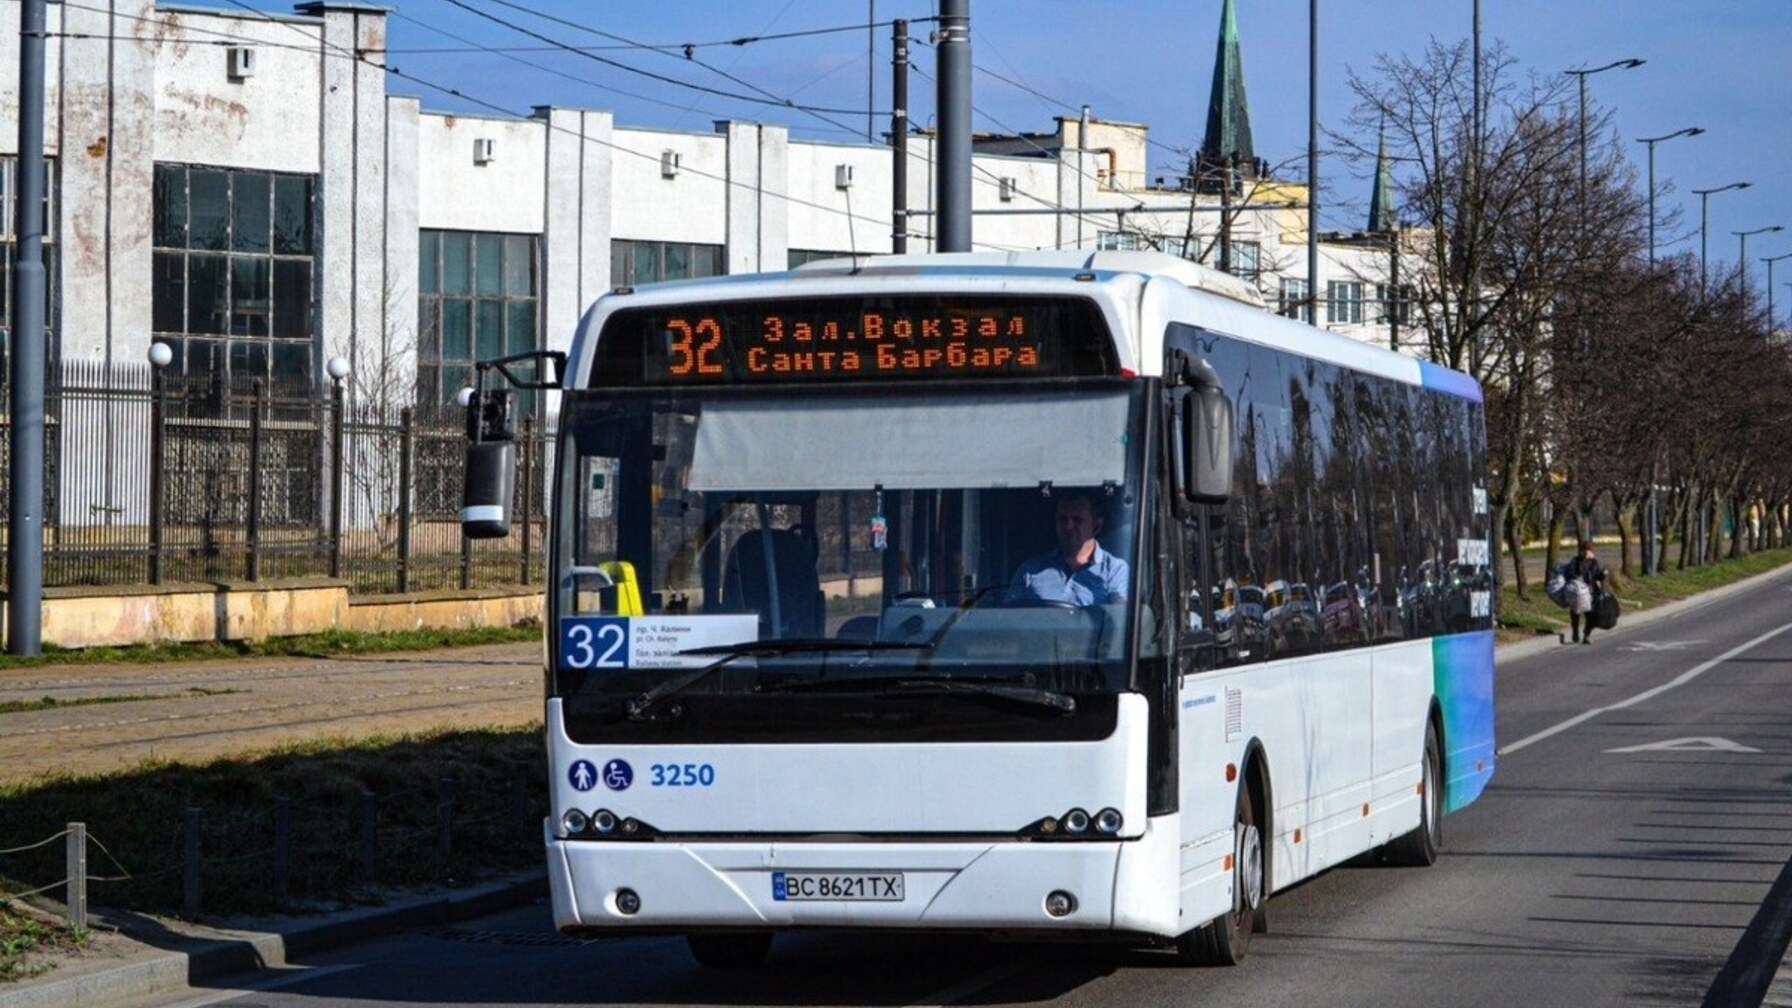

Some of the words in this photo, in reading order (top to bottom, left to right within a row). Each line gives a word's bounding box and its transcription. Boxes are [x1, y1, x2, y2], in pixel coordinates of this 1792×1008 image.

[667, 318, 722, 374] 32
[748, 346, 860, 372] Санта
[877, 342, 1037, 370] Барбара
[566, 623, 625, 669] 32
[651, 764, 714, 787] 3250
